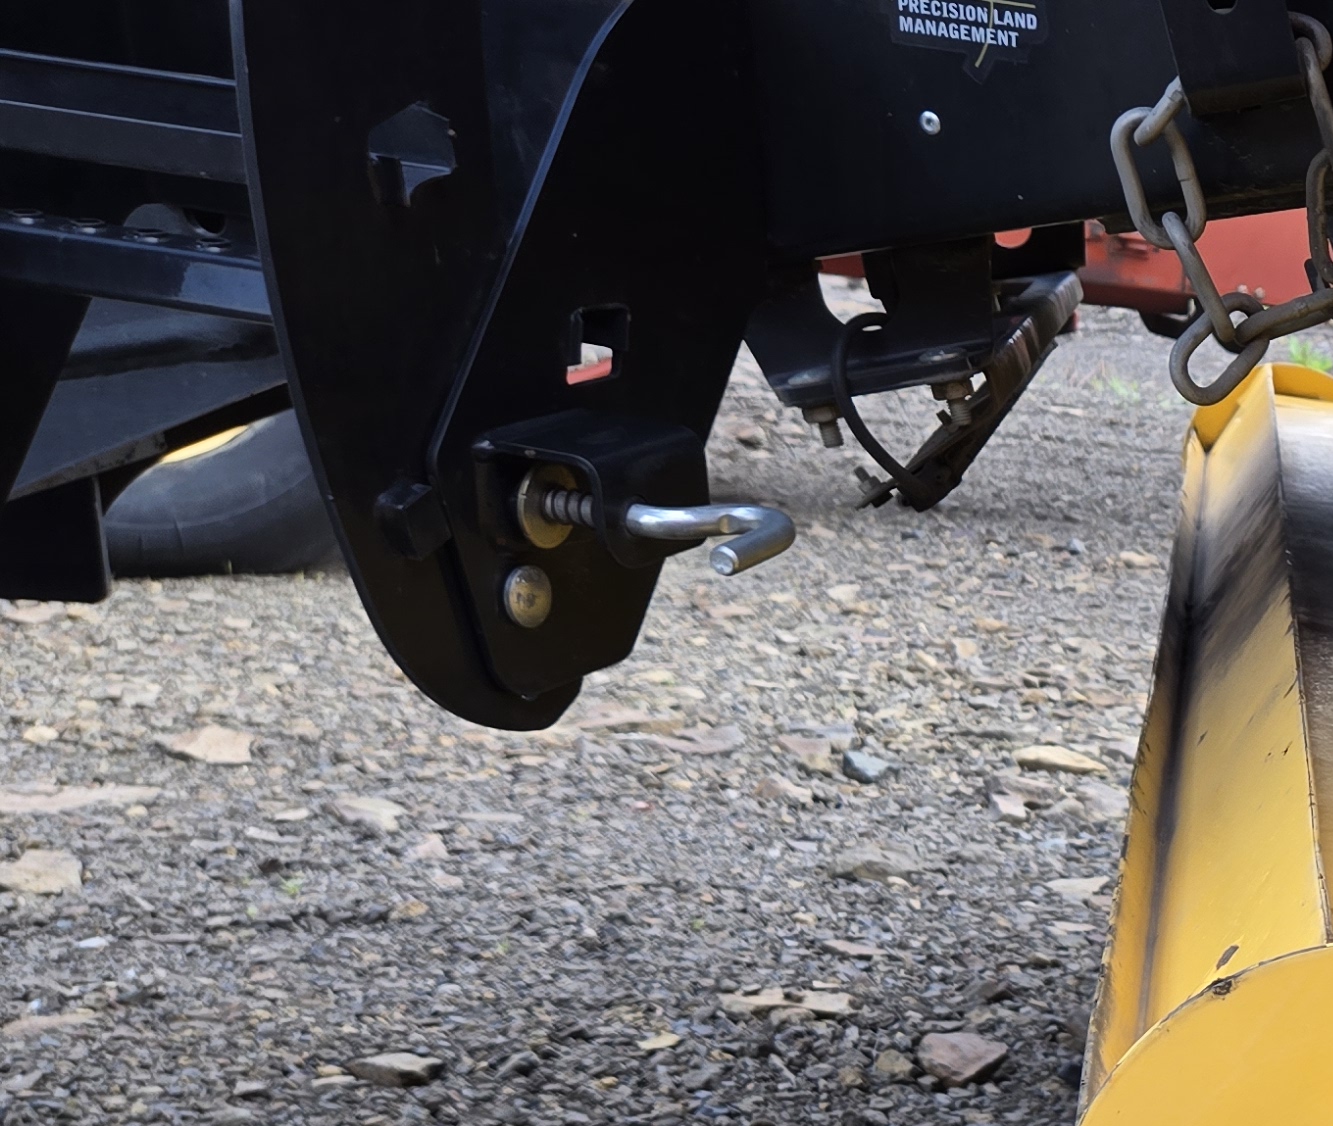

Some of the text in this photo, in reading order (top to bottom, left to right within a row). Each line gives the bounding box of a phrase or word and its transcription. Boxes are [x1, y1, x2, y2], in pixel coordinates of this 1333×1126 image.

[898, 0, 1038, 31] PRECISION LAND
[899, 15, 1019, 48] MANAGEMENT
